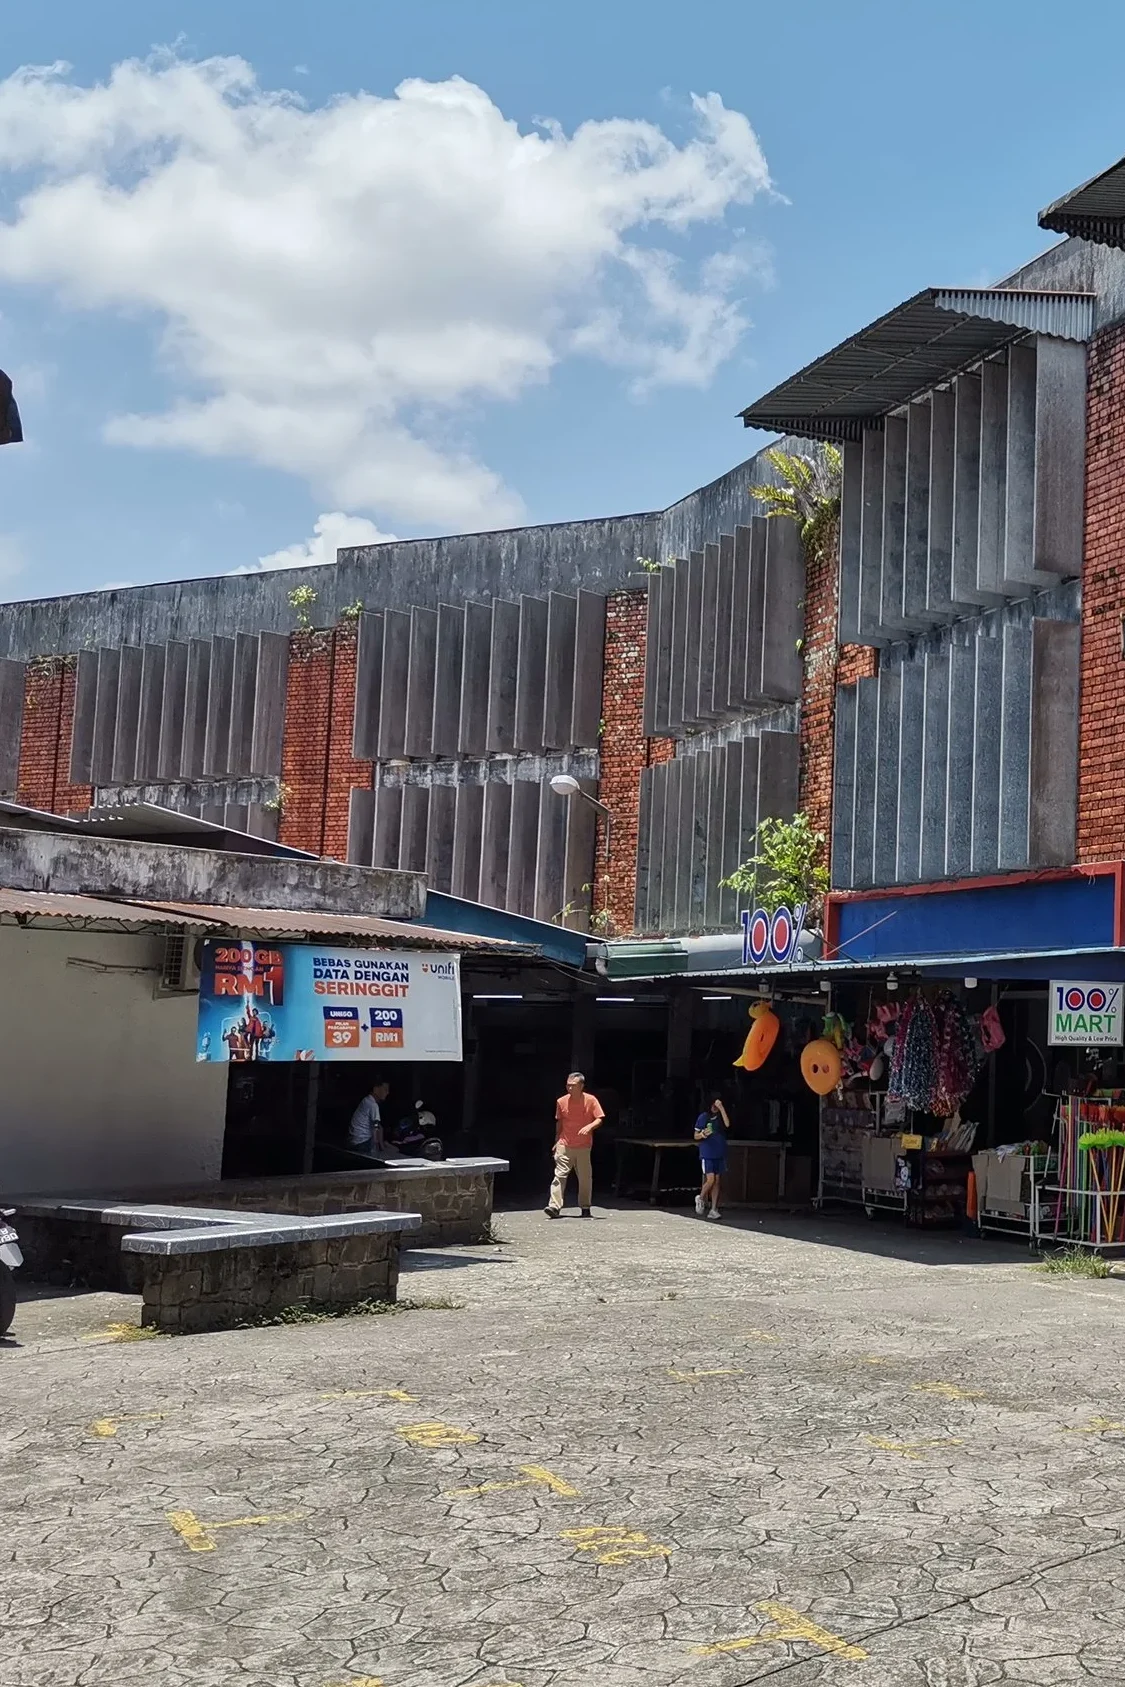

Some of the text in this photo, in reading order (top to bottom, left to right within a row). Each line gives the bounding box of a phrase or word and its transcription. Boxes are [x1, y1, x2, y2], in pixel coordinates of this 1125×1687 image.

[741, 901, 807, 965] 100%
[214, 947, 284, 965] 200 GB
[312, 957, 409, 971] BEBAS GUNAKAN
[313, 968, 409, 983] DATA DENGAN
[214, 966, 284, 1006] RM1
[313, 981, 410, 998] SERINGGIT
[1057, 987, 1119, 1013] 100%
[374, 1010, 398, 1021] 200
[1056, 1013, 1116, 1033] MART
[332, 1031, 352, 1044] 39
[375, 1032, 399, 1043] RM1
[1069, 1035, 1087, 1043] Quality
